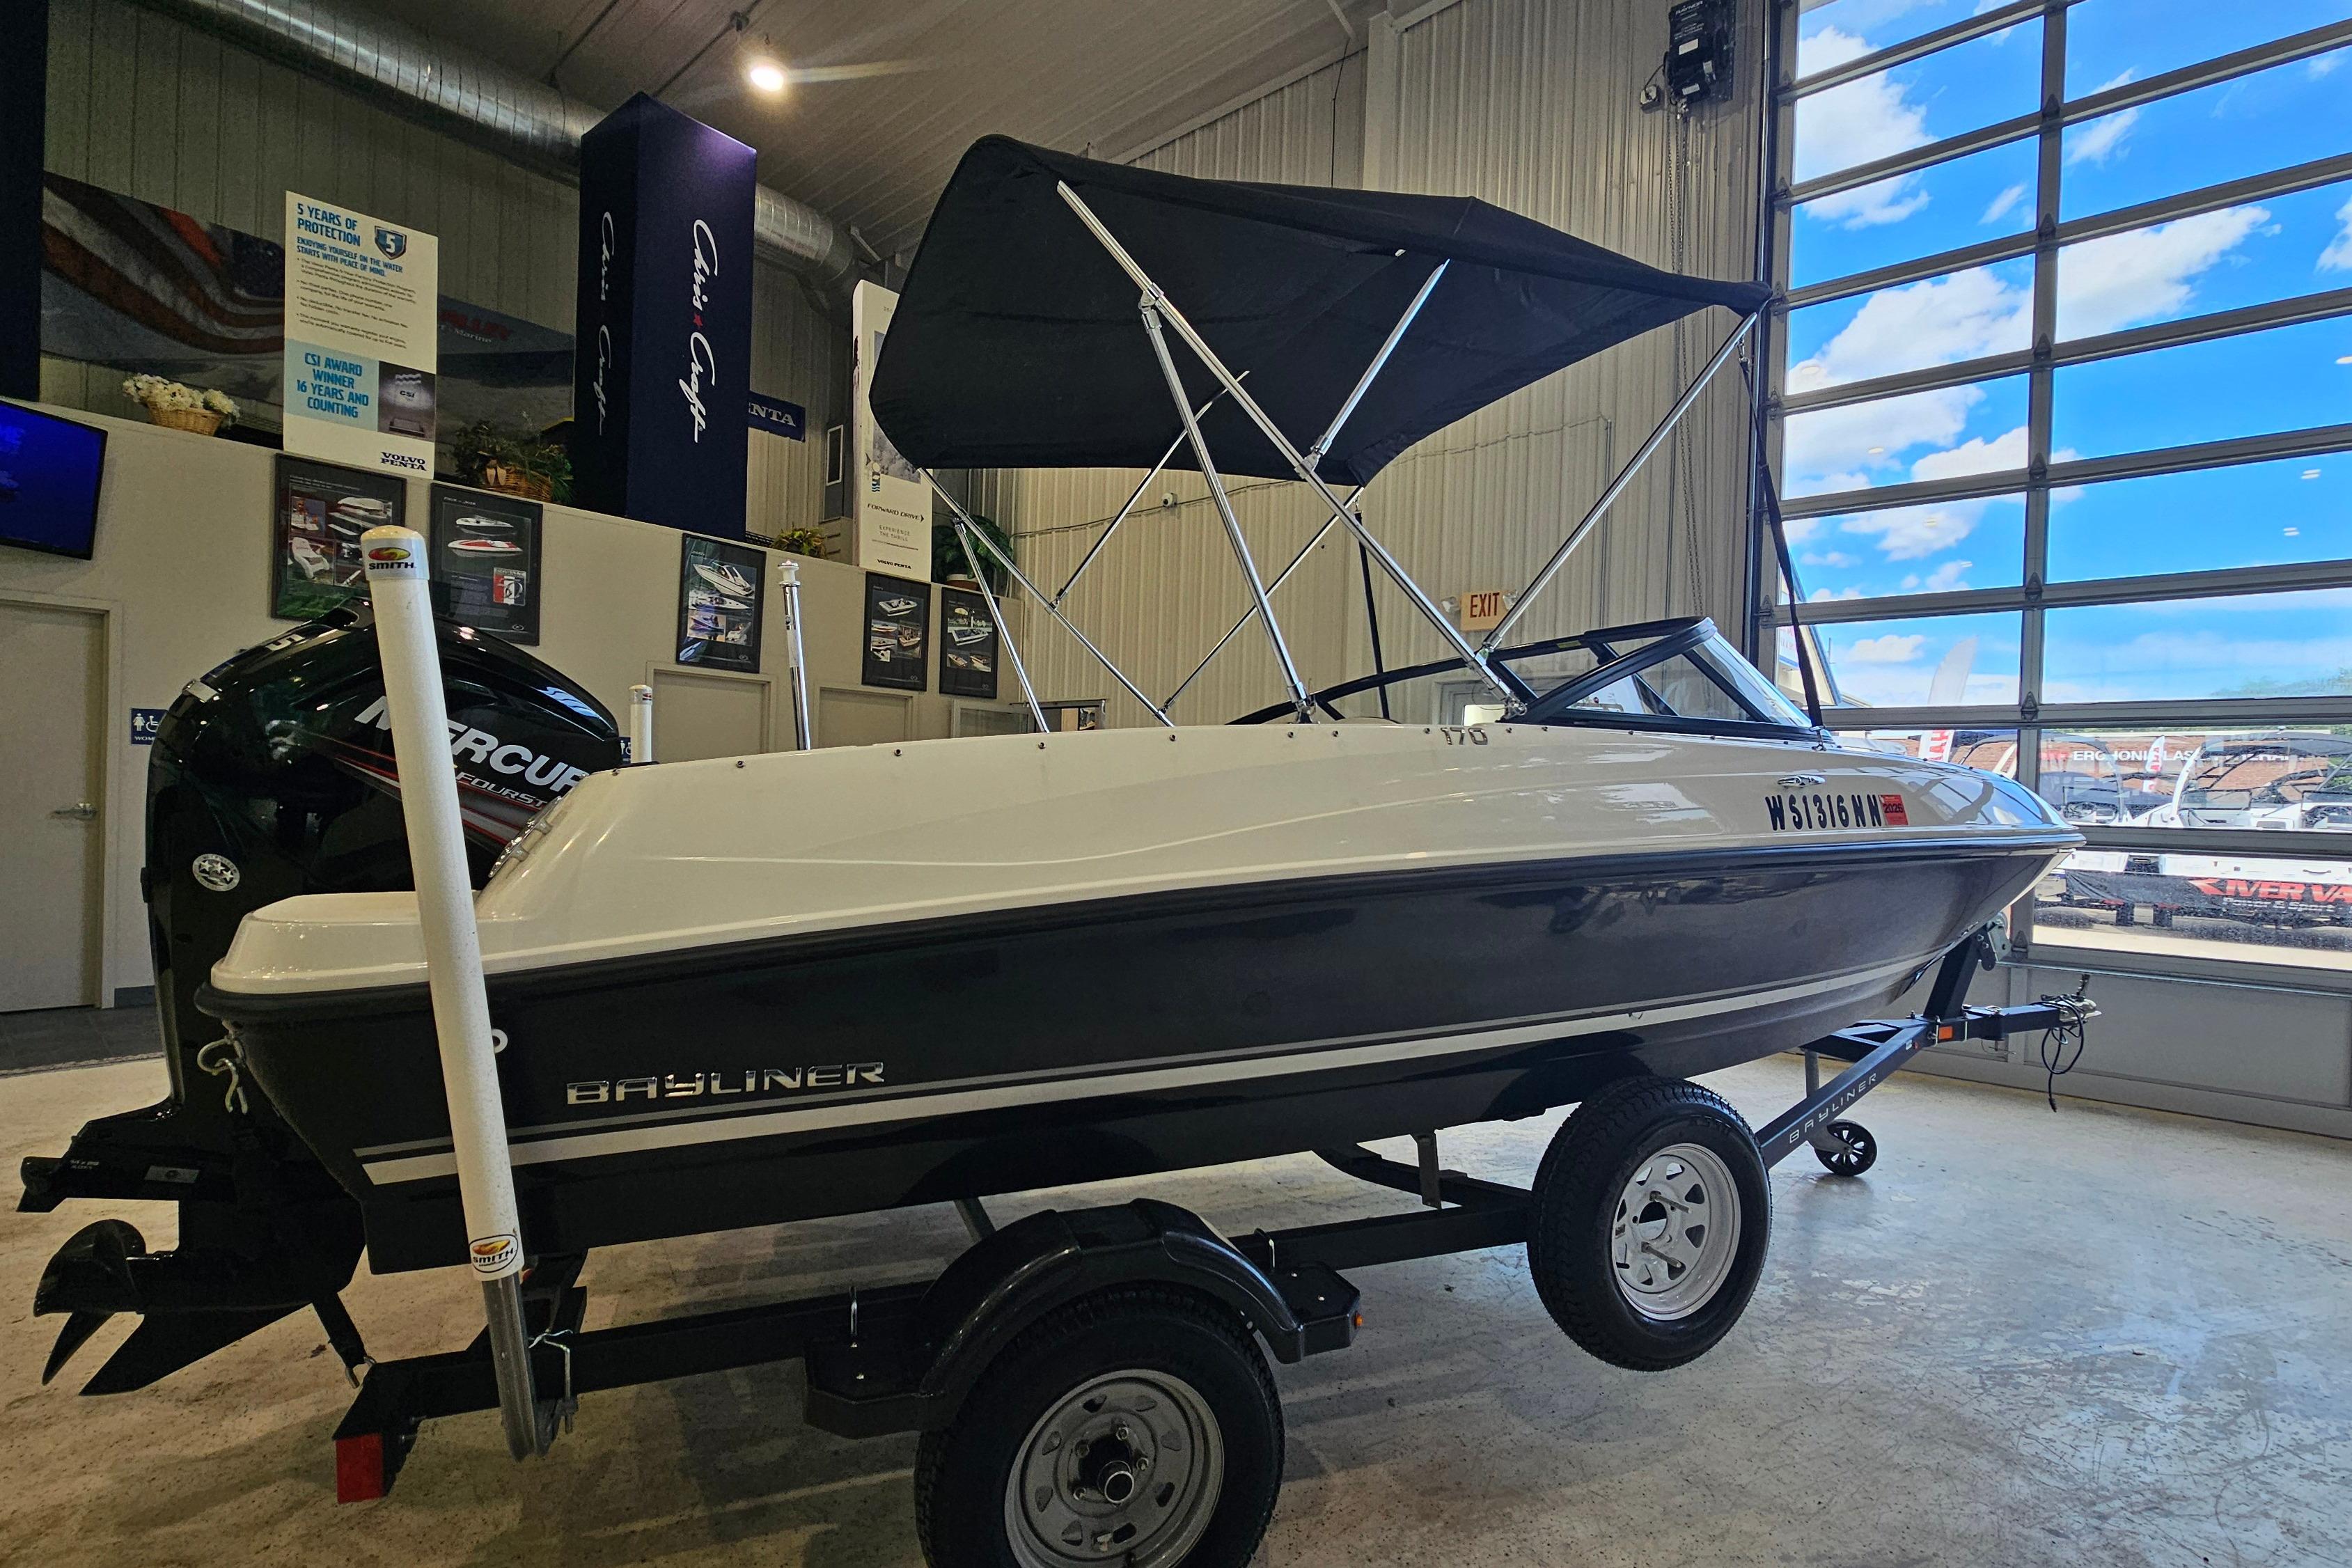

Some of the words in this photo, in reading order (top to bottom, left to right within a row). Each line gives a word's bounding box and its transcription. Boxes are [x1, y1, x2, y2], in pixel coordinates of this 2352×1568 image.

[297, 203, 303, 214] 5
[307, 205, 341, 227] YEARS
[345, 218, 357, 231] OF
[297, 218, 360, 246] PROTECTION
[386, 234, 395, 253] 5
[297, 237, 327, 251] ENJOYING
[329, 244, 357, 259] YOURSELF
[360, 254, 368, 262] ON
[370, 258, 381, 267] THE
[383, 260, 402, 273] WATER
[297, 245, 320, 258] STARTS
[322, 253, 338, 263] WITH
[340, 258, 358, 269] PEACE
[600, 210, 615, 301] Chris
[693, 219, 718, 312] Chris
[305, 352, 320, 367] CSI
[324, 356, 362, 377] AWARD
[313, 368, 354, 389] WINNER
[297, 379, 307, 393] 16
[311, 383, 344, 401] YEARS
[347, 394, 368, 407] AND
[593, 324, 612, 436] Craft
[679, 331, 716, 443] Craft
[308, 397, 359, 418] COUNTING
[748, 401, 796, 427] NTA
[380, 452, 425, 464] VOLVO
[381, 457, 427, 471] PENTA
[1469, 592, 1500, 618] EXIT
[354, 695, 590, 792] MRCUR
[1440, 727, 1488, 745] 170
[455, 771, 548, 808] FOURST
[1883, 803, 1904, 814] 2026
[567, 1061, 885, 1106] BAYLINER
[1789, 1072, 1877, 1144] BAYLINER
